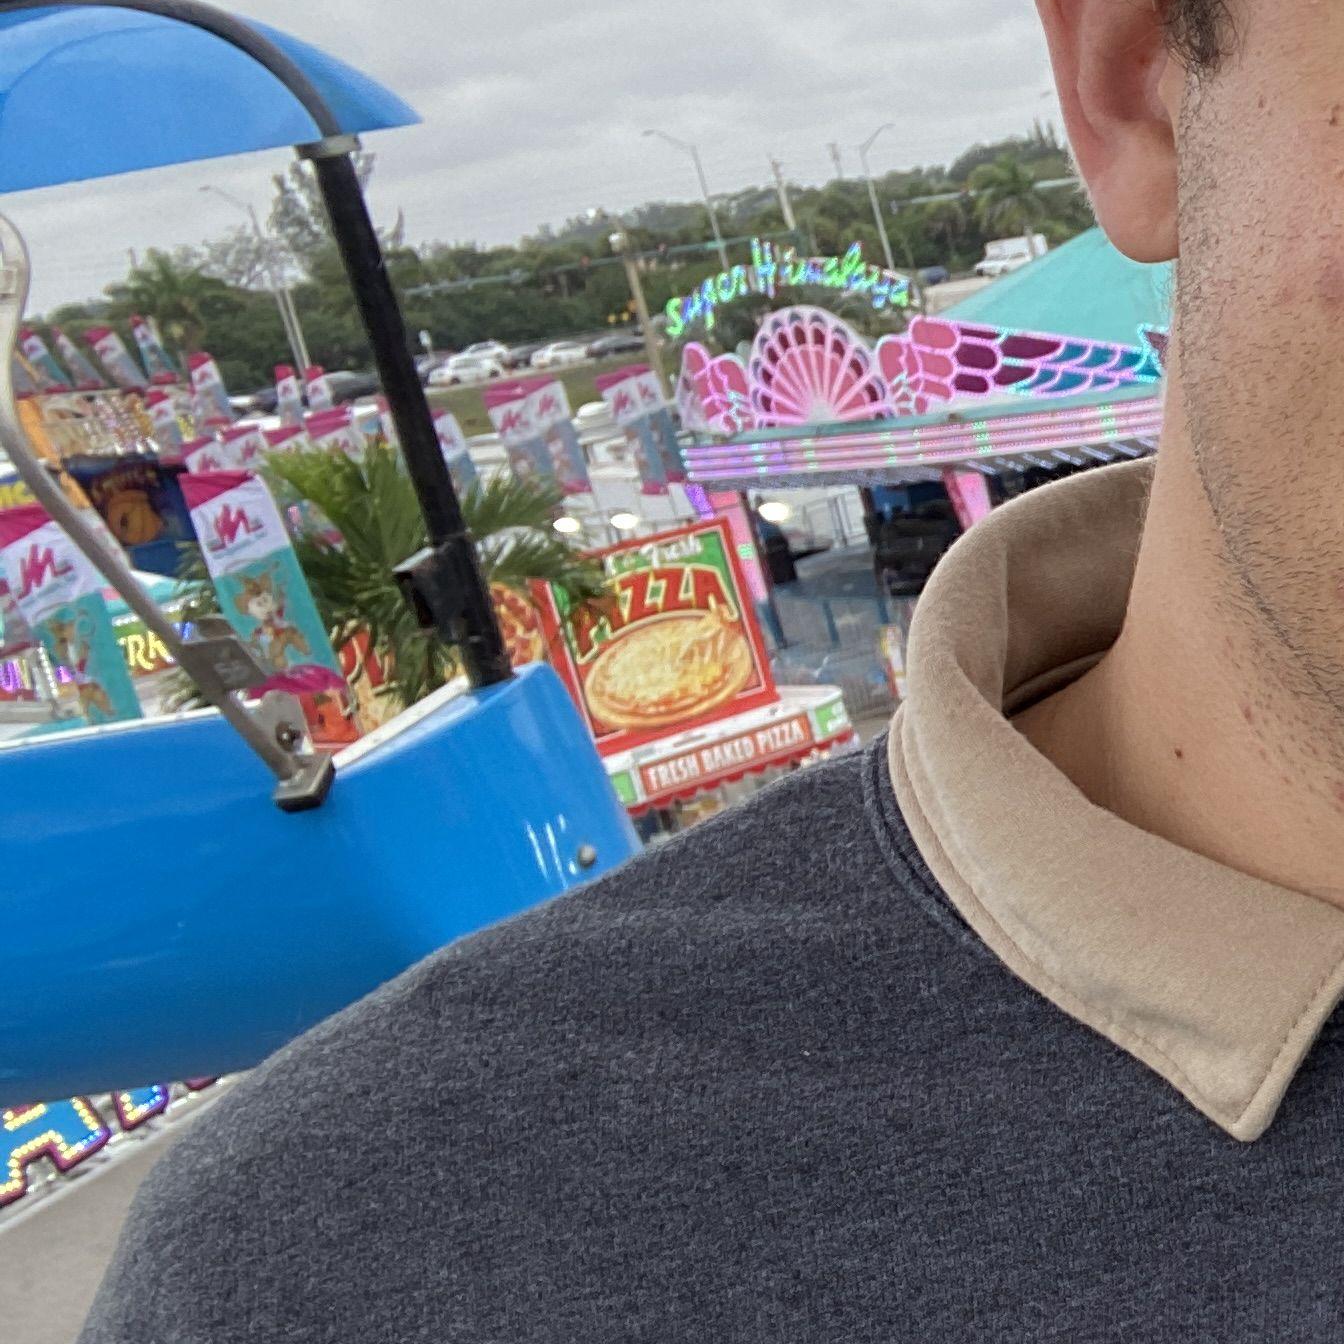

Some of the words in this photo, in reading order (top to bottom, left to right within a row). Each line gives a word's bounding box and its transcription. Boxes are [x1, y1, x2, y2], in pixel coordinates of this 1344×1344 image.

[647, 754, 700, 791] FRESH
[701, 737, 755, 772] BAKED
[756, 719, 805, 755] PIZZA
